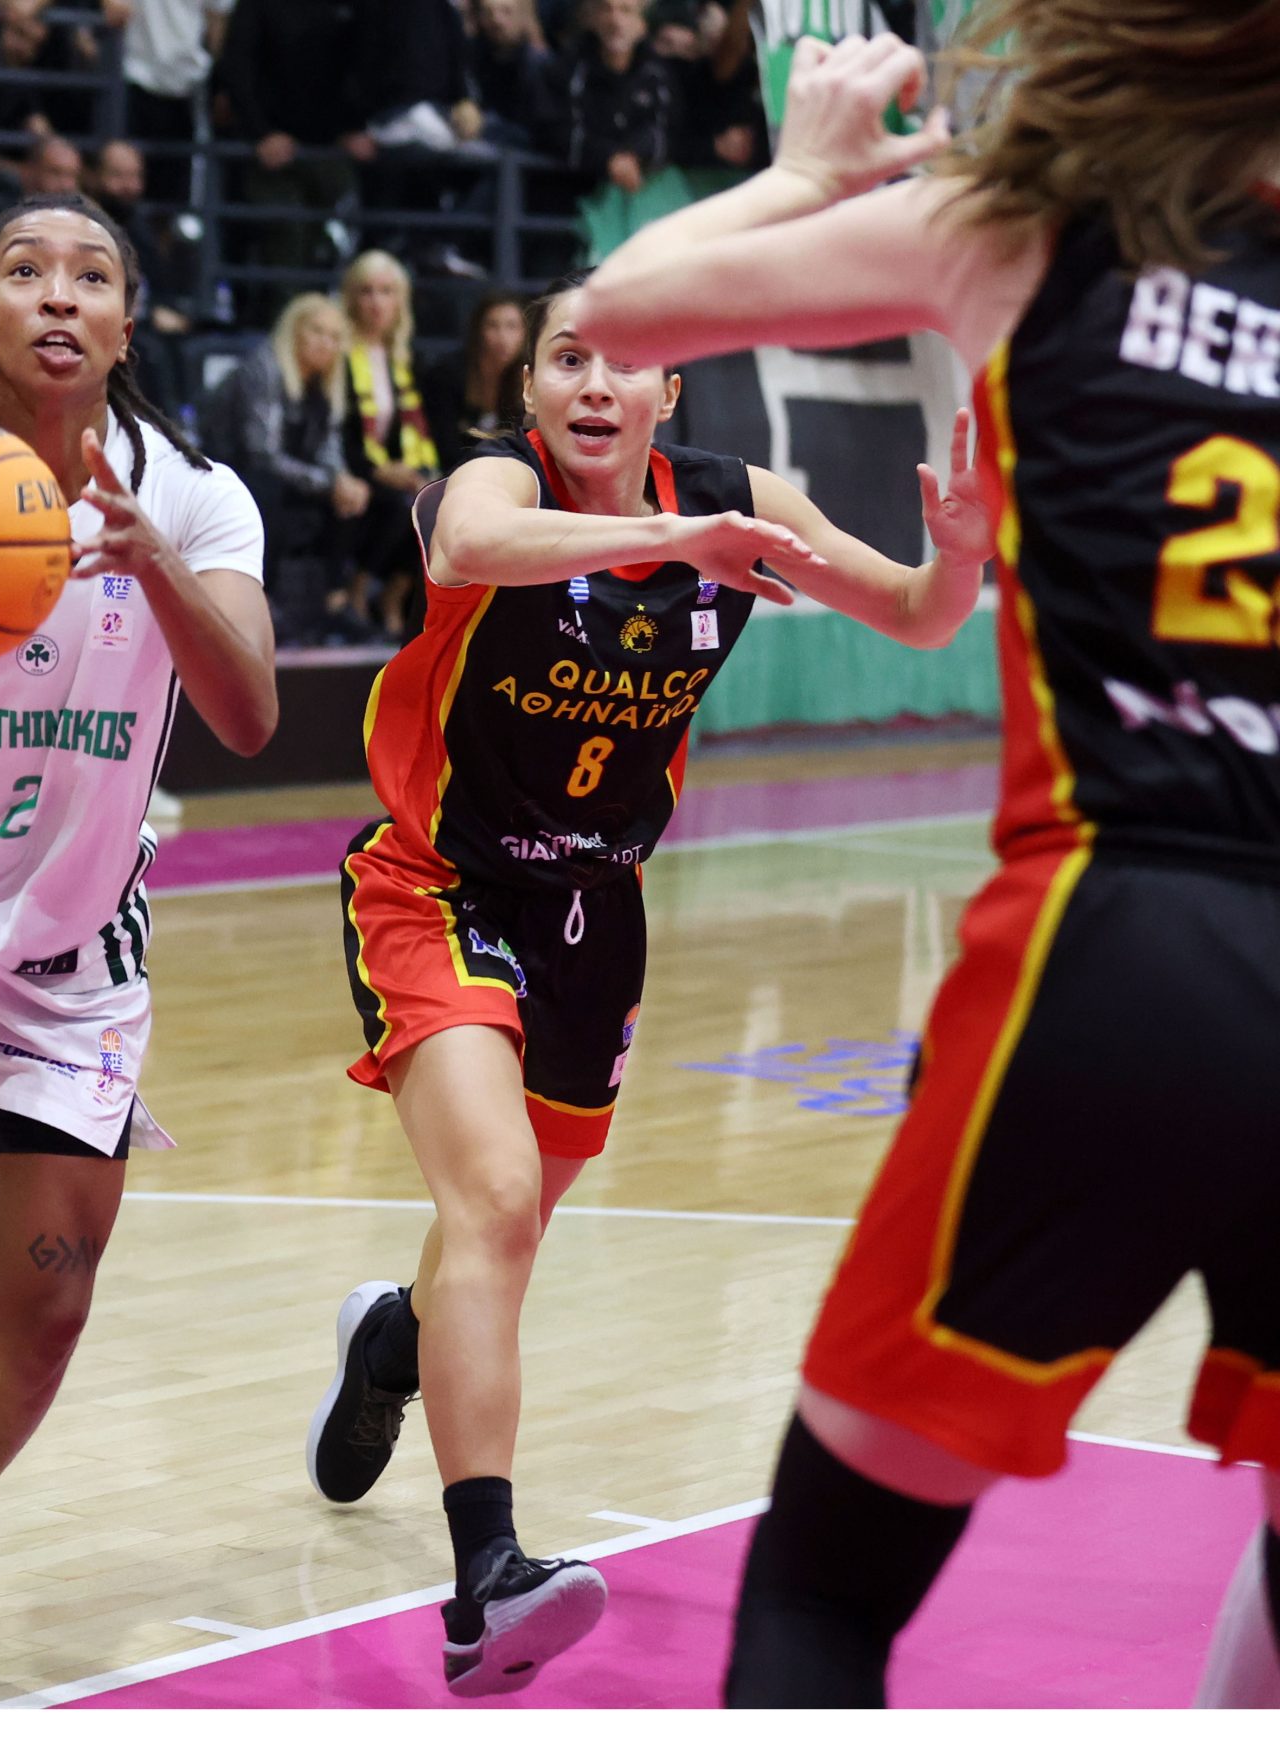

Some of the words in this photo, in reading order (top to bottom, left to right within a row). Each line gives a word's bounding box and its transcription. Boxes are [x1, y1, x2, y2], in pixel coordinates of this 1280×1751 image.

[1150, 433, 1280, 648] 2
[492, 675, 700, 730] ΑΘΗΝΑΪΚΟ
[548, 659, 709, 700] QUALCO
[566, 735, 615, 798] 8
